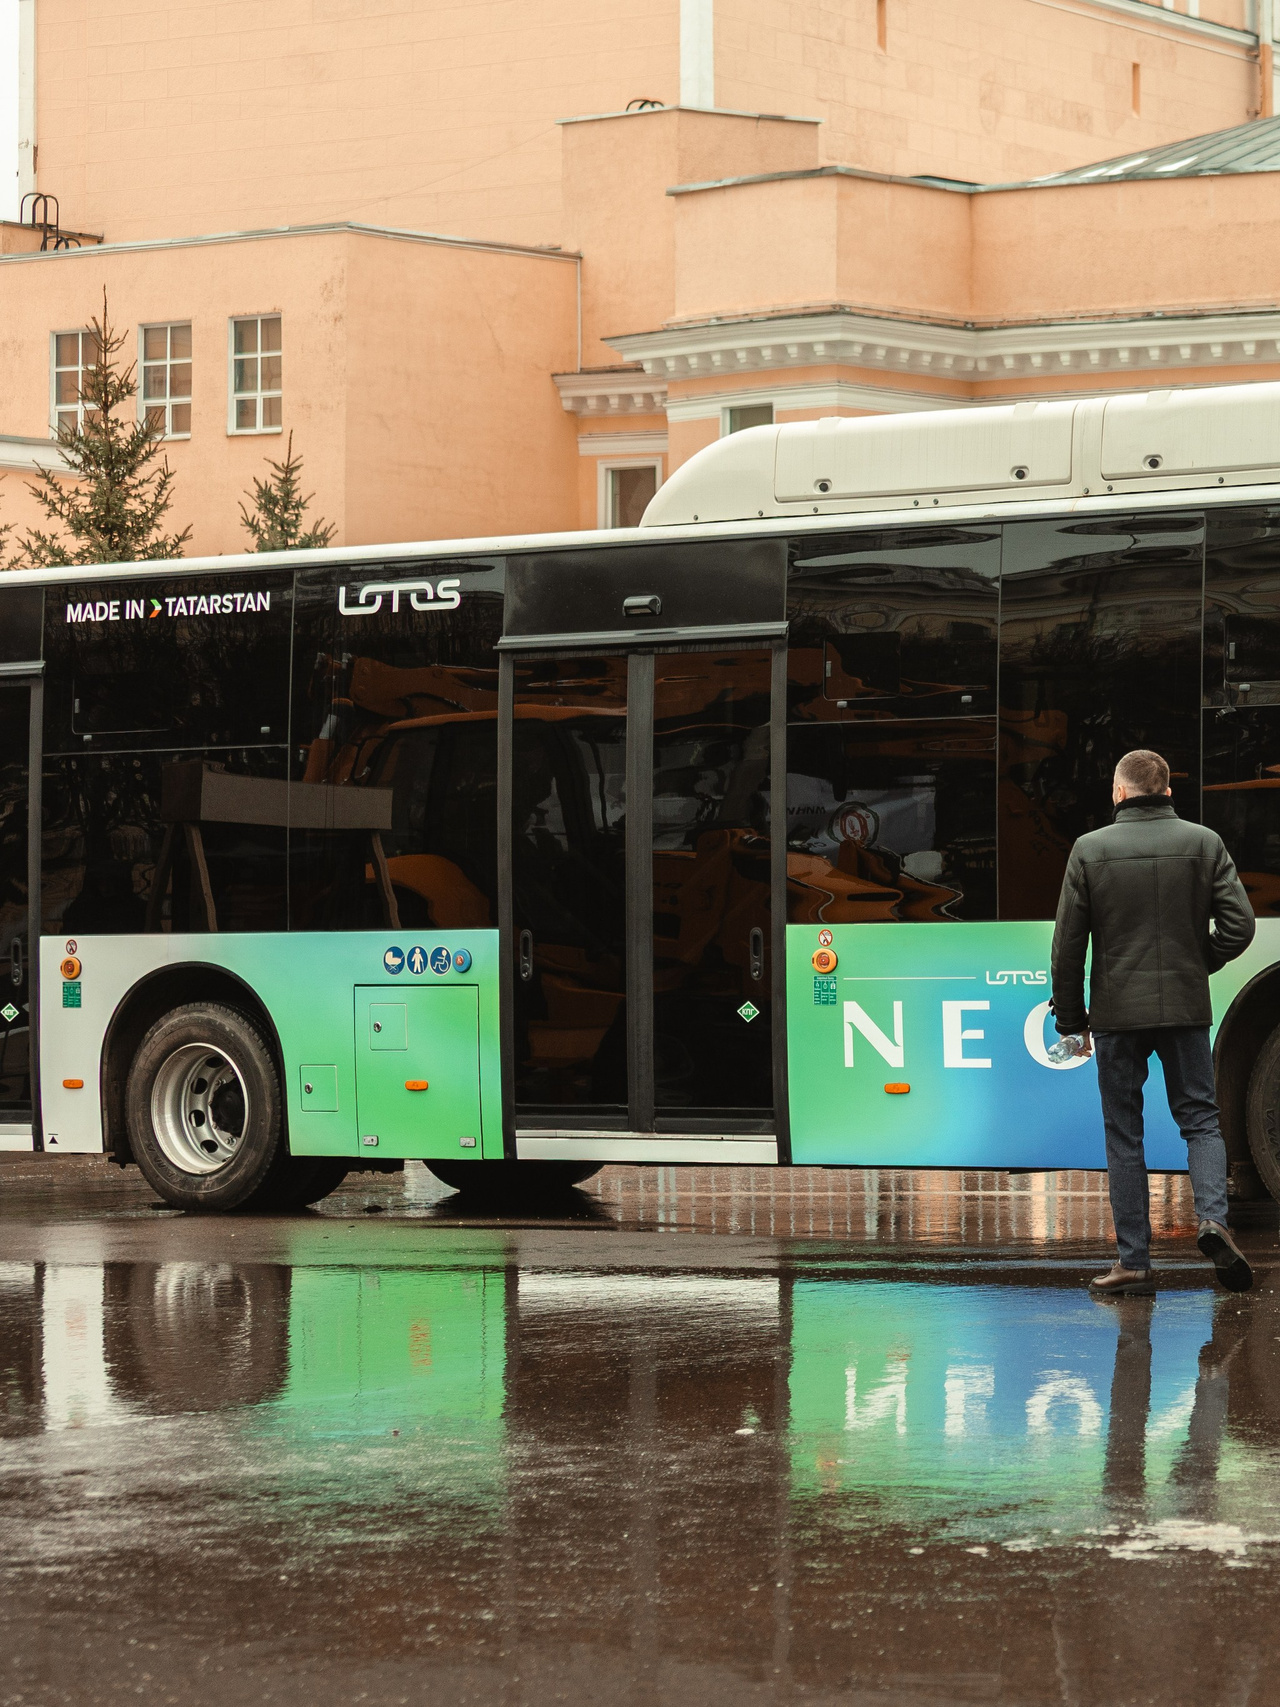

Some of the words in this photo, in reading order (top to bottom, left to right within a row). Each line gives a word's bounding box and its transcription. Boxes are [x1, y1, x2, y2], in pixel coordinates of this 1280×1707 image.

[66, 601, 120, 623] MADE
[125, 599, 144, 620] IN
[165, 591, 271, 617] TATARSTAN
[338, 578, 461, 616] LOTOS
[986, 970, 1048, 985] LOTOS
